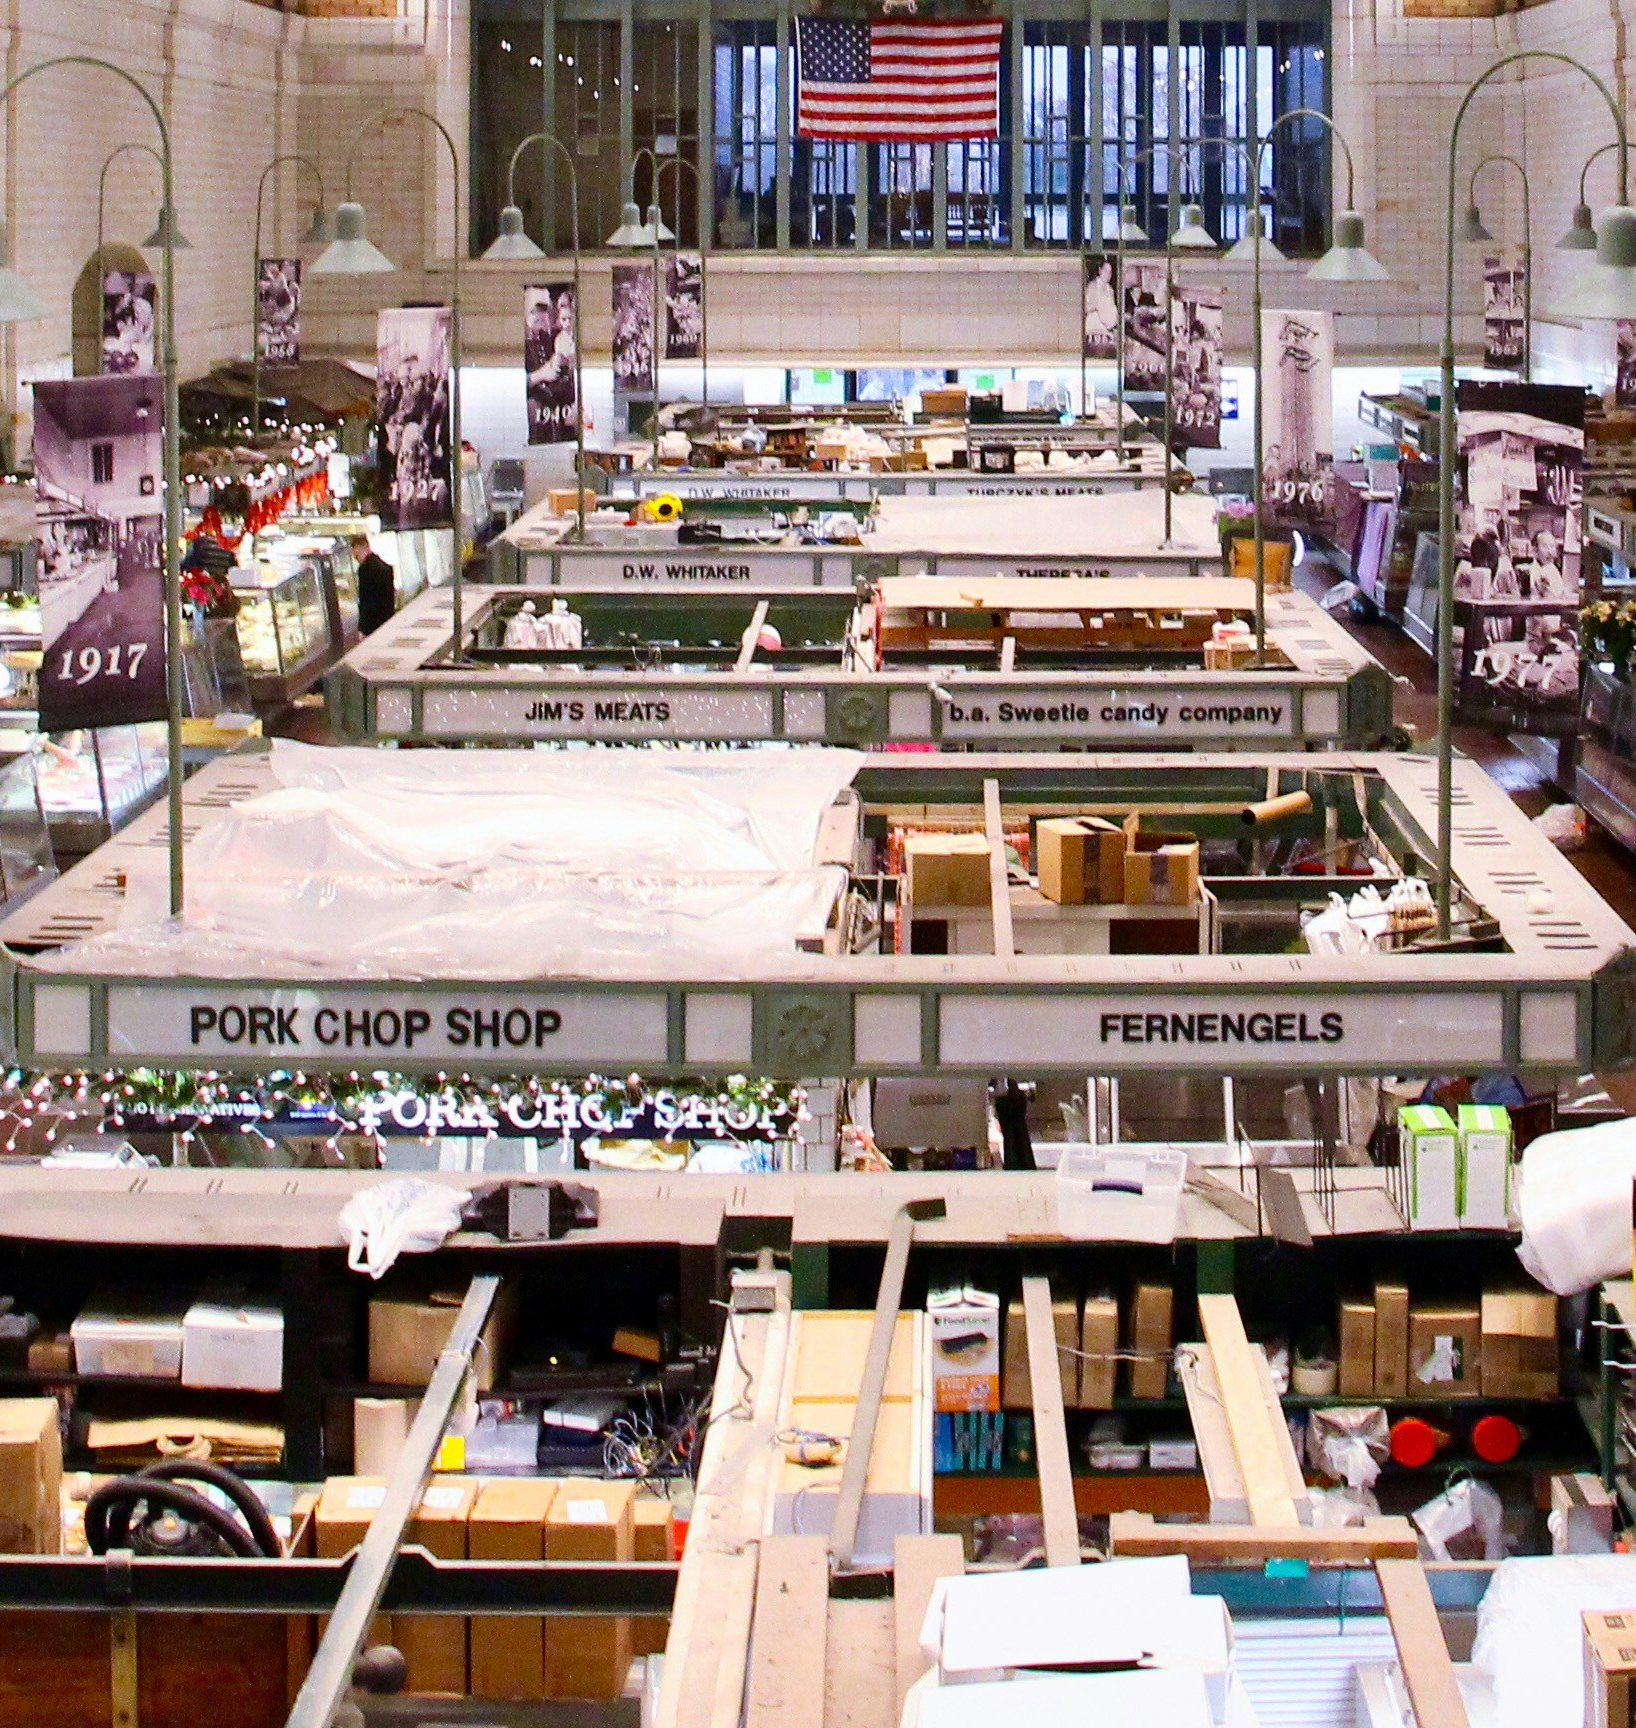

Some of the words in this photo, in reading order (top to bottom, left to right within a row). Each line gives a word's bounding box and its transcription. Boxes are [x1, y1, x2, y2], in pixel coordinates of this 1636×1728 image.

[1175, 404, 1216, 428] 1972
[388, 478, 446, 504] 1927
[1271, 480, 1324, 505] 1976
[622, 564, 659, 581] D.W.
[666, 564, 751, 581] WHITAKER
[57, 641, 149, 686] 1917
[1470, 648, 1561, 691] 1977
[524, 701, 584, 721] JIM'S
[594, 701, 670, 722] MEATS
[949, 703, 990, 722] b.a.
[998, 702, 1090, 722] Sweetie
[1100, 703, 1169, 726] candy
[1178, 707, 1283, 727] company
[190, 1004, 300, 1046] PORK
[314, 1007, 431, 1049] CHOP
[446, 1006, 562, 1050] SHOP
[1099, 1012, 1344, 1043] FERNENGELS
[361, 1088, 501, 1131] PORK
